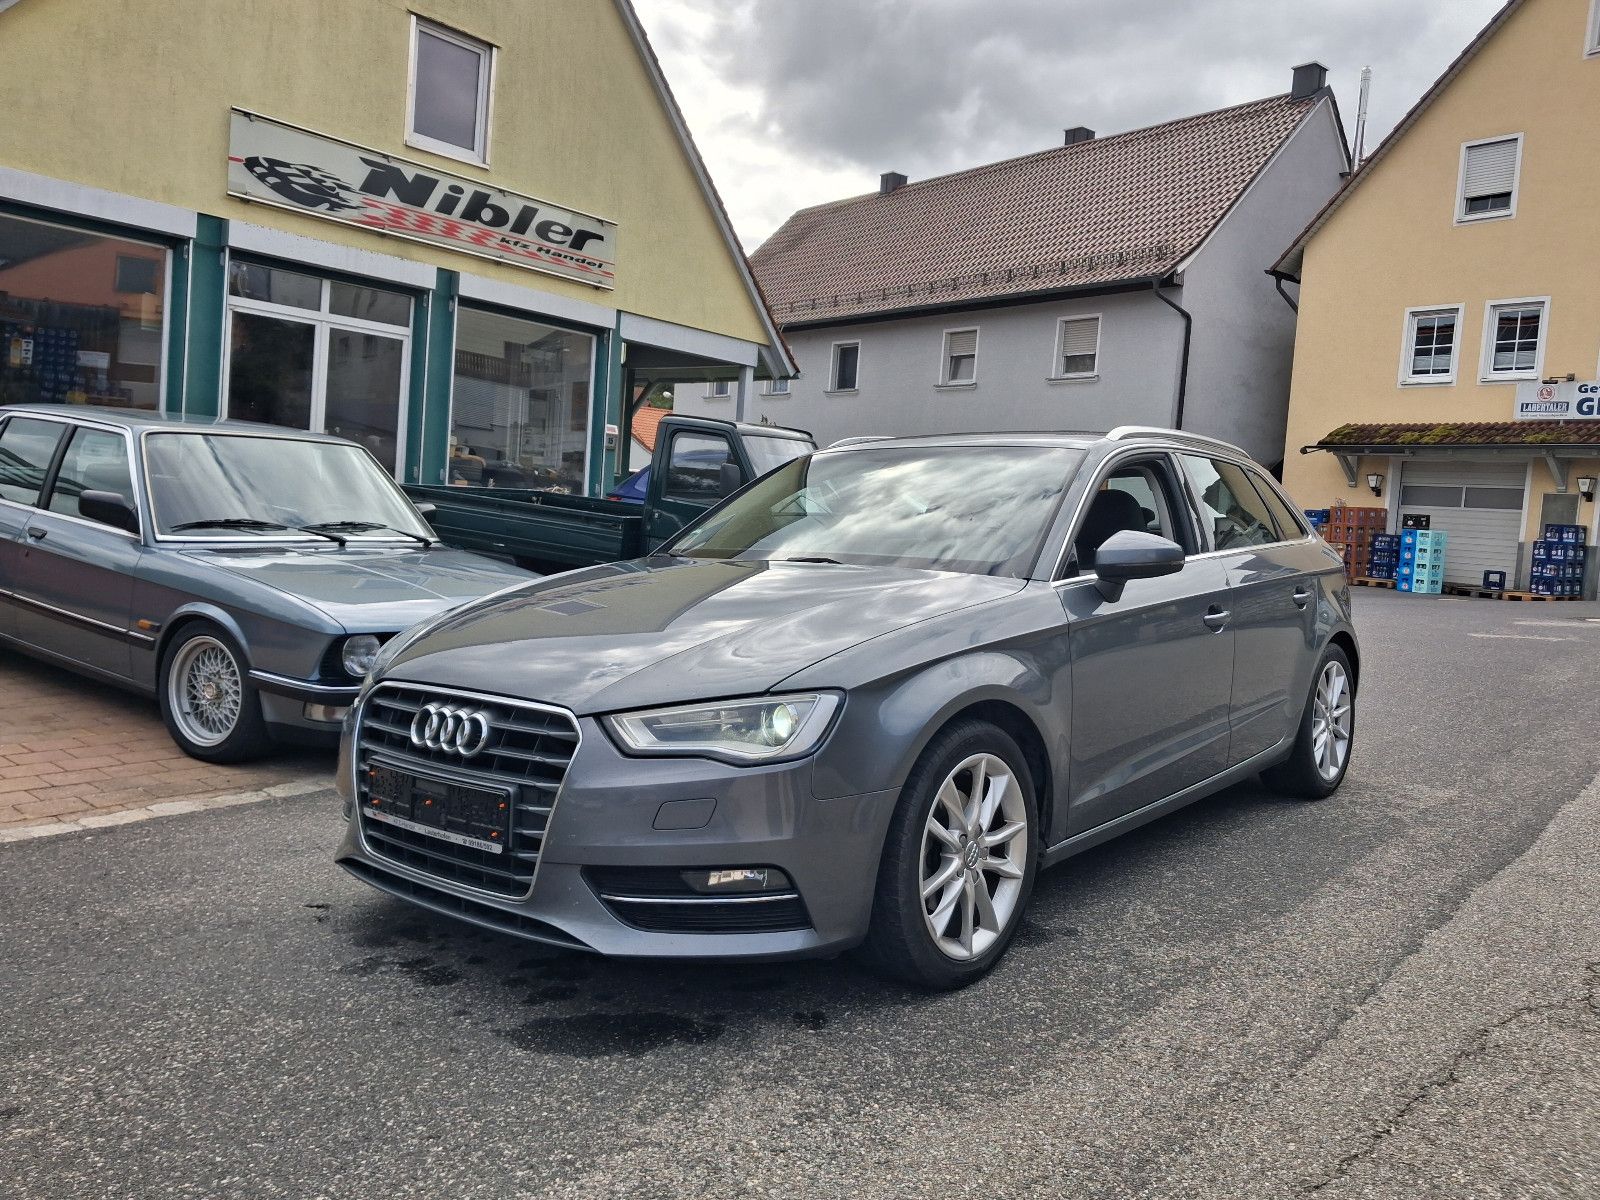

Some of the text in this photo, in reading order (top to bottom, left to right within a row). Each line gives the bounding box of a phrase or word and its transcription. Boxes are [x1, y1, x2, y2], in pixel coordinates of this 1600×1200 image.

[359, 156, 604, 251] Nibler
[537, 247, 603, 268] Handel
[1578, 384, 1600, 393] Ge
